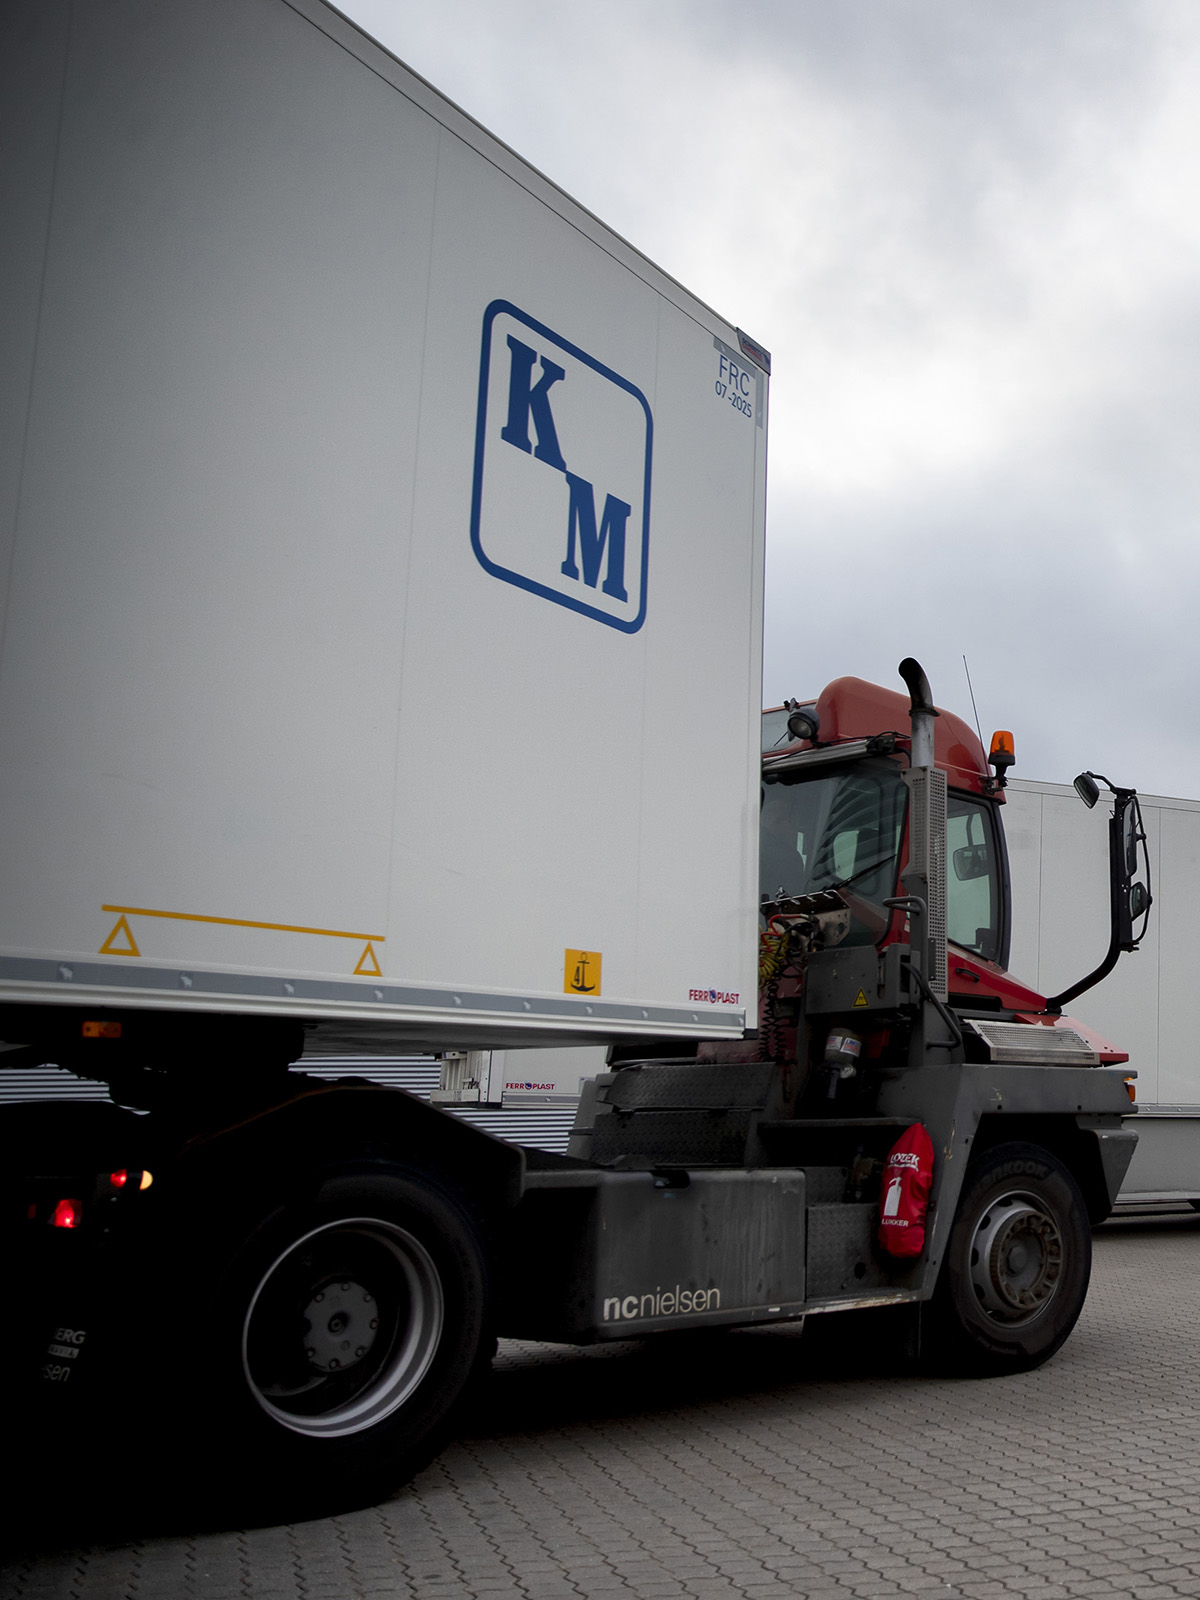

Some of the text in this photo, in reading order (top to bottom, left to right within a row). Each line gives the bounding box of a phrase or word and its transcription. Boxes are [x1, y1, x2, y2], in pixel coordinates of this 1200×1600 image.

[719, 353, 750, 397] FRC
[501, 333, 567, 474] K
[560, 470, 632, 604] M
[688, 988, 740, 1005] FERROPLAST
[505, 1081, 556, 1090] FERROPLAST
